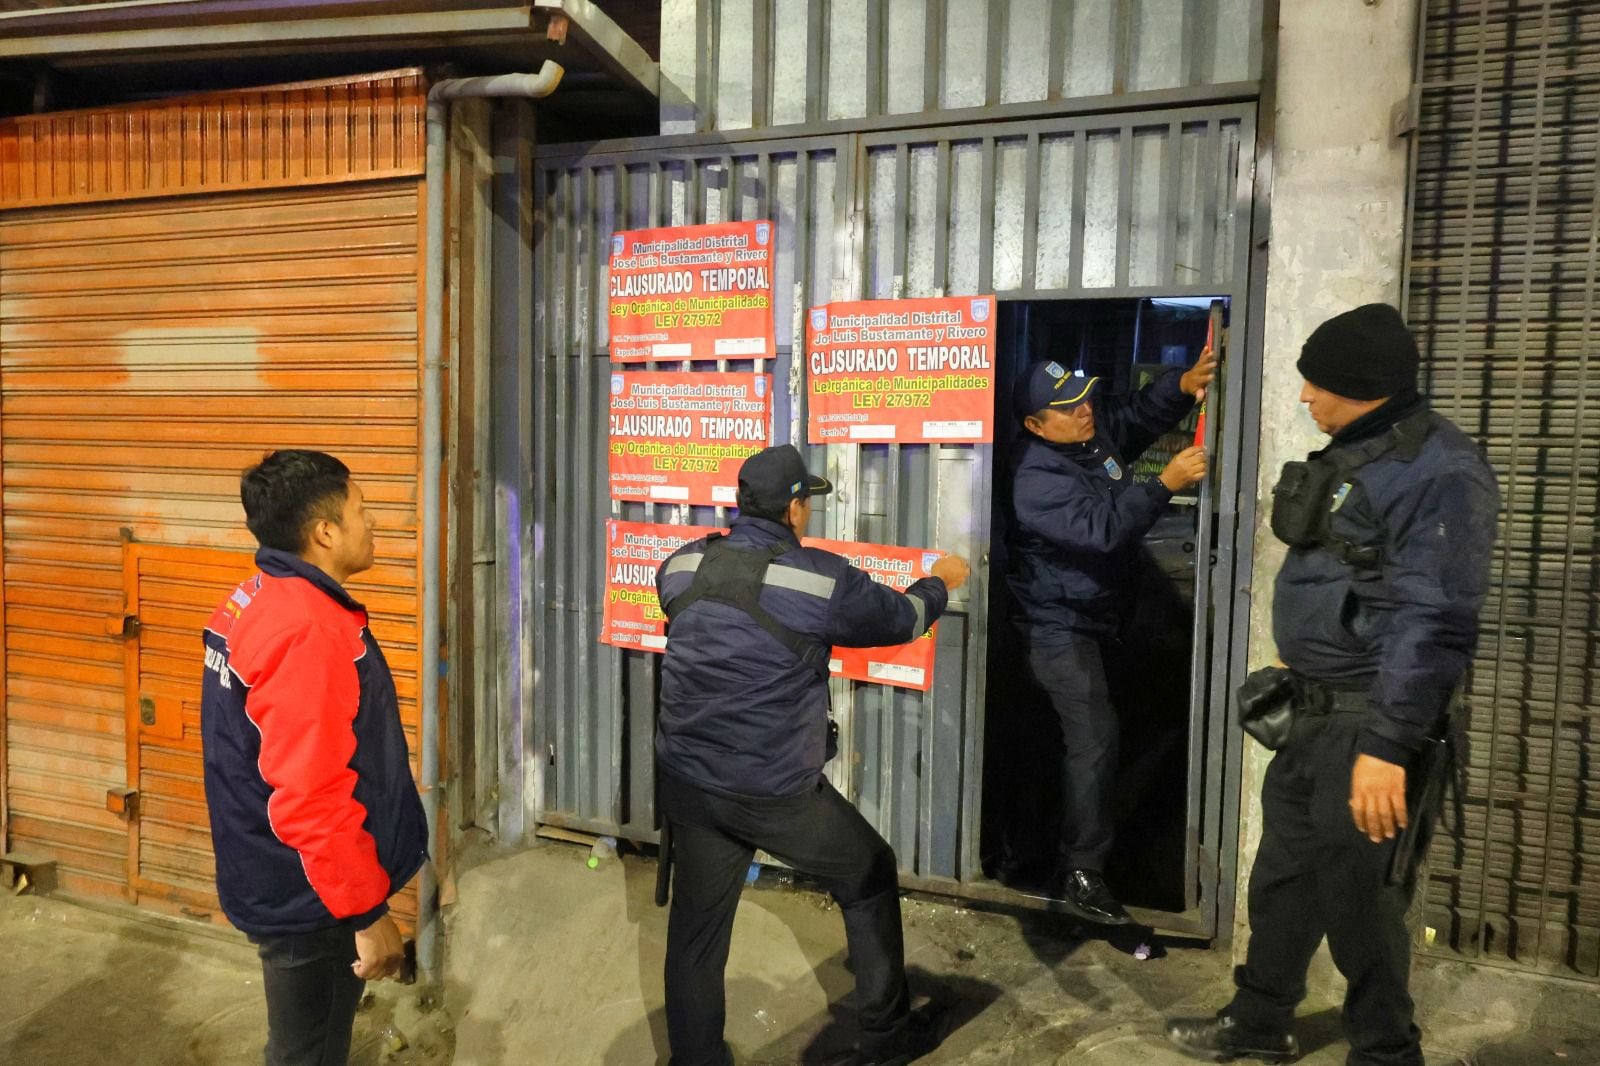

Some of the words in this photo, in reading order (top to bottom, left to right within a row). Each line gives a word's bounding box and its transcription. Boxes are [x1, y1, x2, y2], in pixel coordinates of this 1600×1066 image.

[634, 238, 702, 255] Municipalidad
[705, 234, 748, 249] Distrital
[613, 256, 636, 270] José
[639, 255, 658, 267] Luis
[661, 251, 724, 266] Bustamante
[726, 254, 732, 263] y
[632, 300, 672, 315] Orgánica
[674, 299, 686, 311] de
[689, 296, 768, 312] Municipalidades
[655, 314, 679, 328] LEY
[683, 312, 721, 327] 27972
[912, 310, 961, 325] Distrital
[833, 331, 856, 342] Luis
[860, 328, 933, 341] Bustamante
[935, 330, 944, 342] y
[947, 327, 986, 339] Rivero
[907, 345, 990, 371] TEMPORAL
[631, 384, 702, 397] Municipalidad
[705, 386, 746, 397] Distrital
[876, 378, 890, 390] de
[894, 376, 988, 392] Municipalidades
[612, 397, 633, 409] José
[637, 398, 658, 409] Luis
[661, 399, 722, 411] Bustamante
[724, 402, 731, 413] y
[853, 394, 881, 408] LEY
[886, 393, 930, 407] 27972
[628, 441, 671, 455] Orgánica
[674, 444, 685, 455] de
[654, 458, 678, 470] LEY
[682, 459, 719, 472] 27972
[630, 546, 649, 559] Luis
[864, 556, 912, 572] Distrital
[887, 575, 896, 586] y
